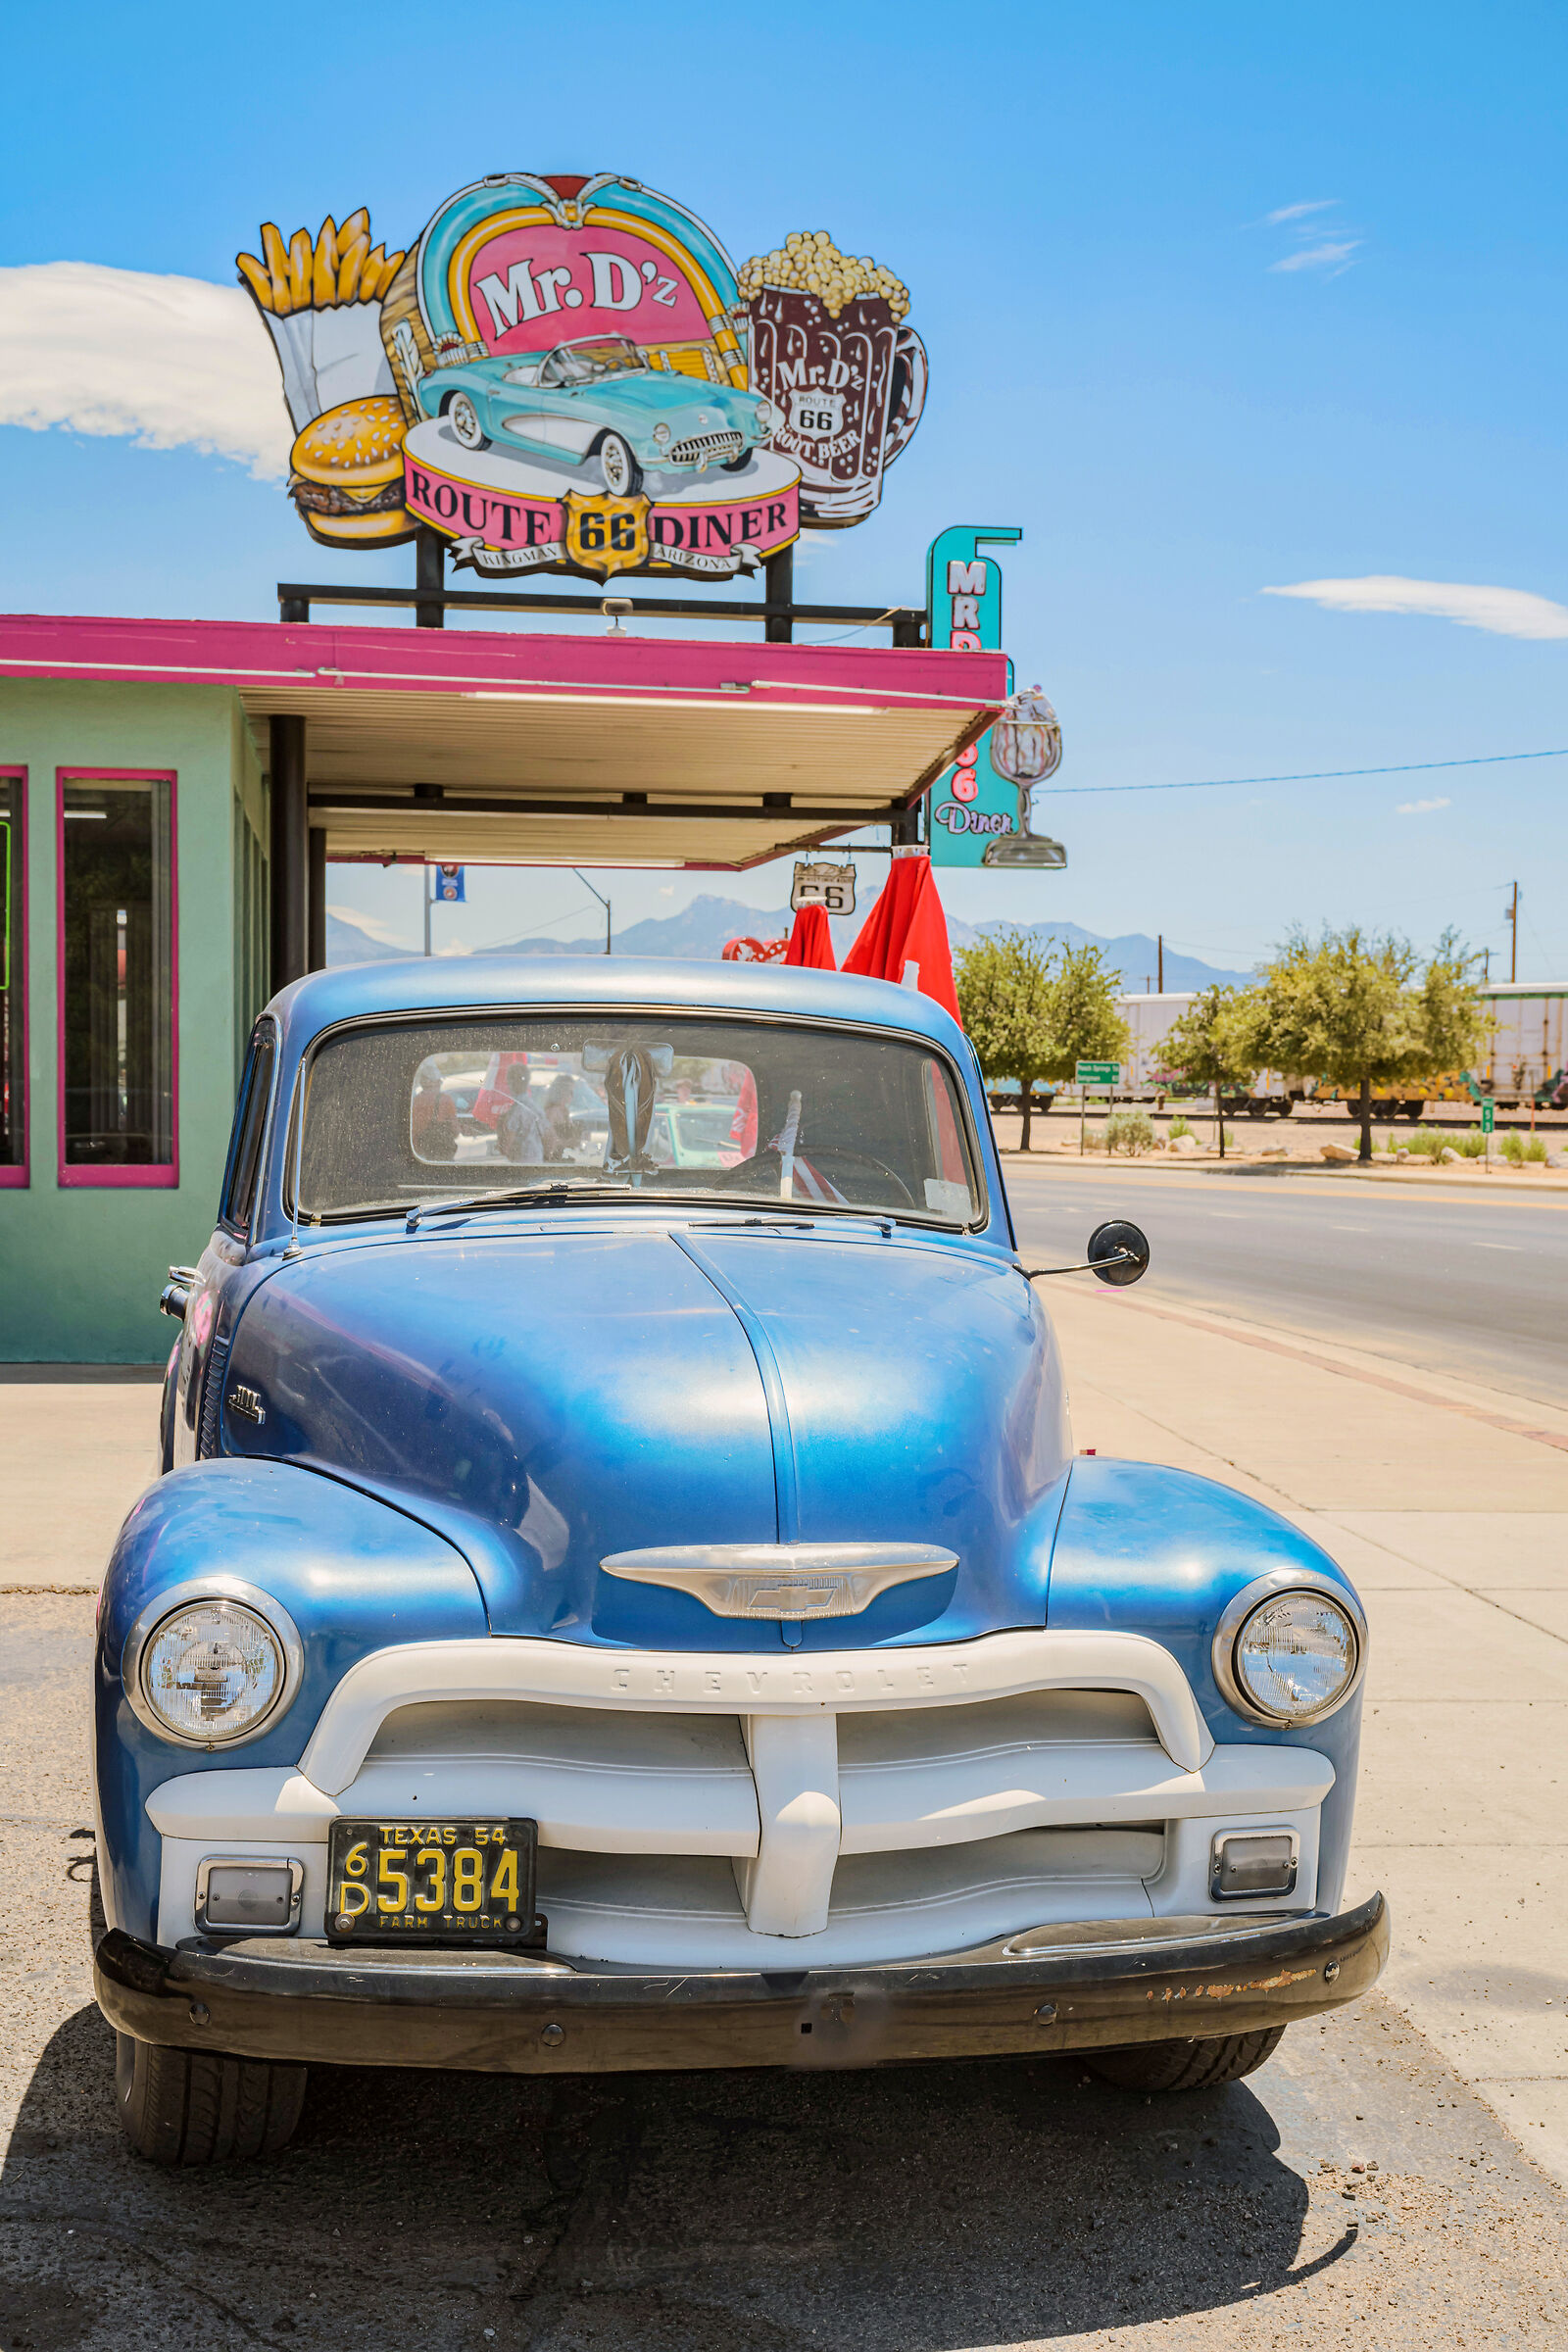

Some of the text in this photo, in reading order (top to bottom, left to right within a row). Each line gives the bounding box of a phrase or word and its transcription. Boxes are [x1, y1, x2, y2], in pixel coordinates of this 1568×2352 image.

[474, 251, 680, 341] Mr. D'z
[776, 357, 826, 391] Mr.
[799, 395, 837, 407] ROUTE
[800, 410, 832, 430] 66
[817, 429, 861, 460] BEER
[412, 469, 787, 551] ROUTE 66 DINER
[483, 546, 732, 569] KINGMAN ARIZONA
[935, 801, 1013, 835] Diner
[611, 1663, 971, 1695] CHEVROLET
[378, 1827, 506, 1846] TEXAS 54
[376, 1847, 519, 1913] 5384
[378, 1913, 504, 1930] FARM TRUCK
